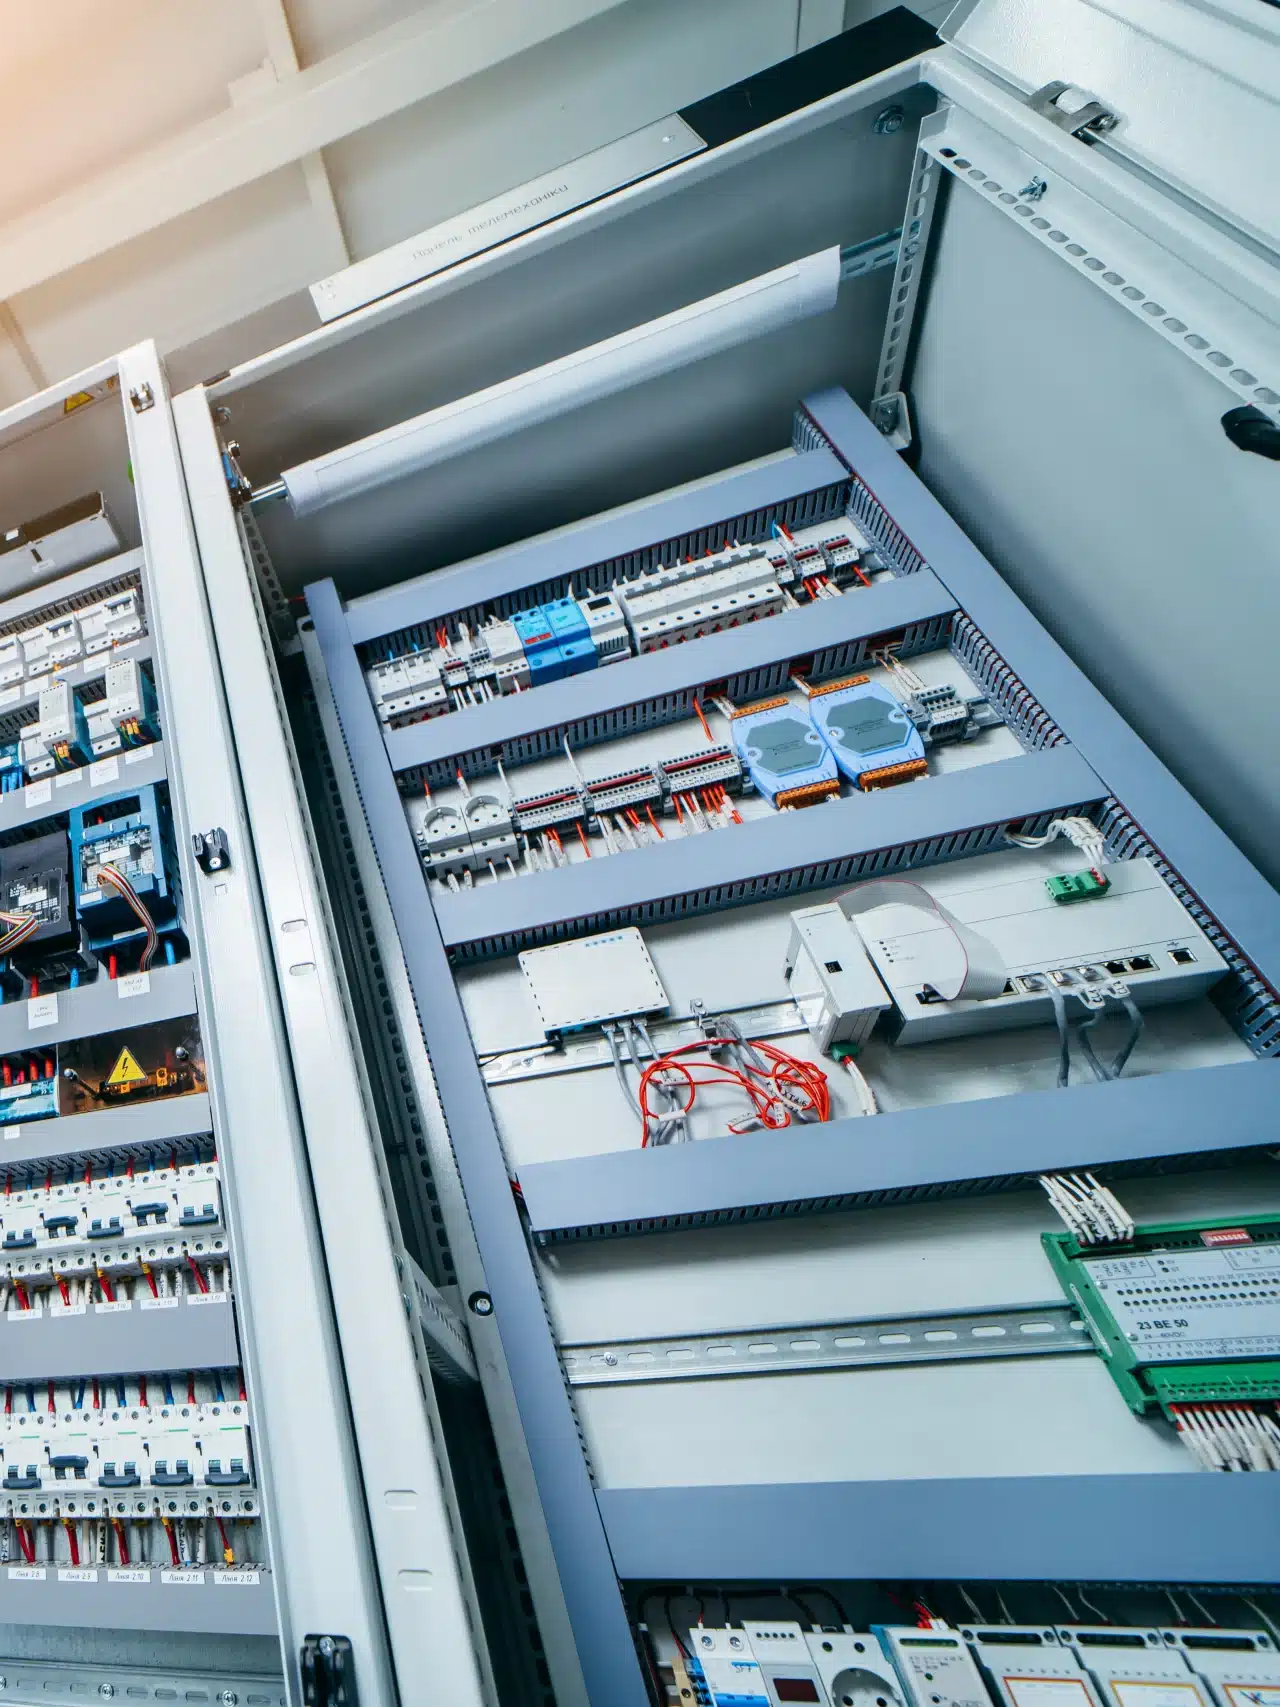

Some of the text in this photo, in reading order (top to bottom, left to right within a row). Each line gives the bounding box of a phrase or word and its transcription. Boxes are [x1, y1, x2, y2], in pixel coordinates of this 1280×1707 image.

[1137, 1318, 1189, 1330] 23 BE 50
